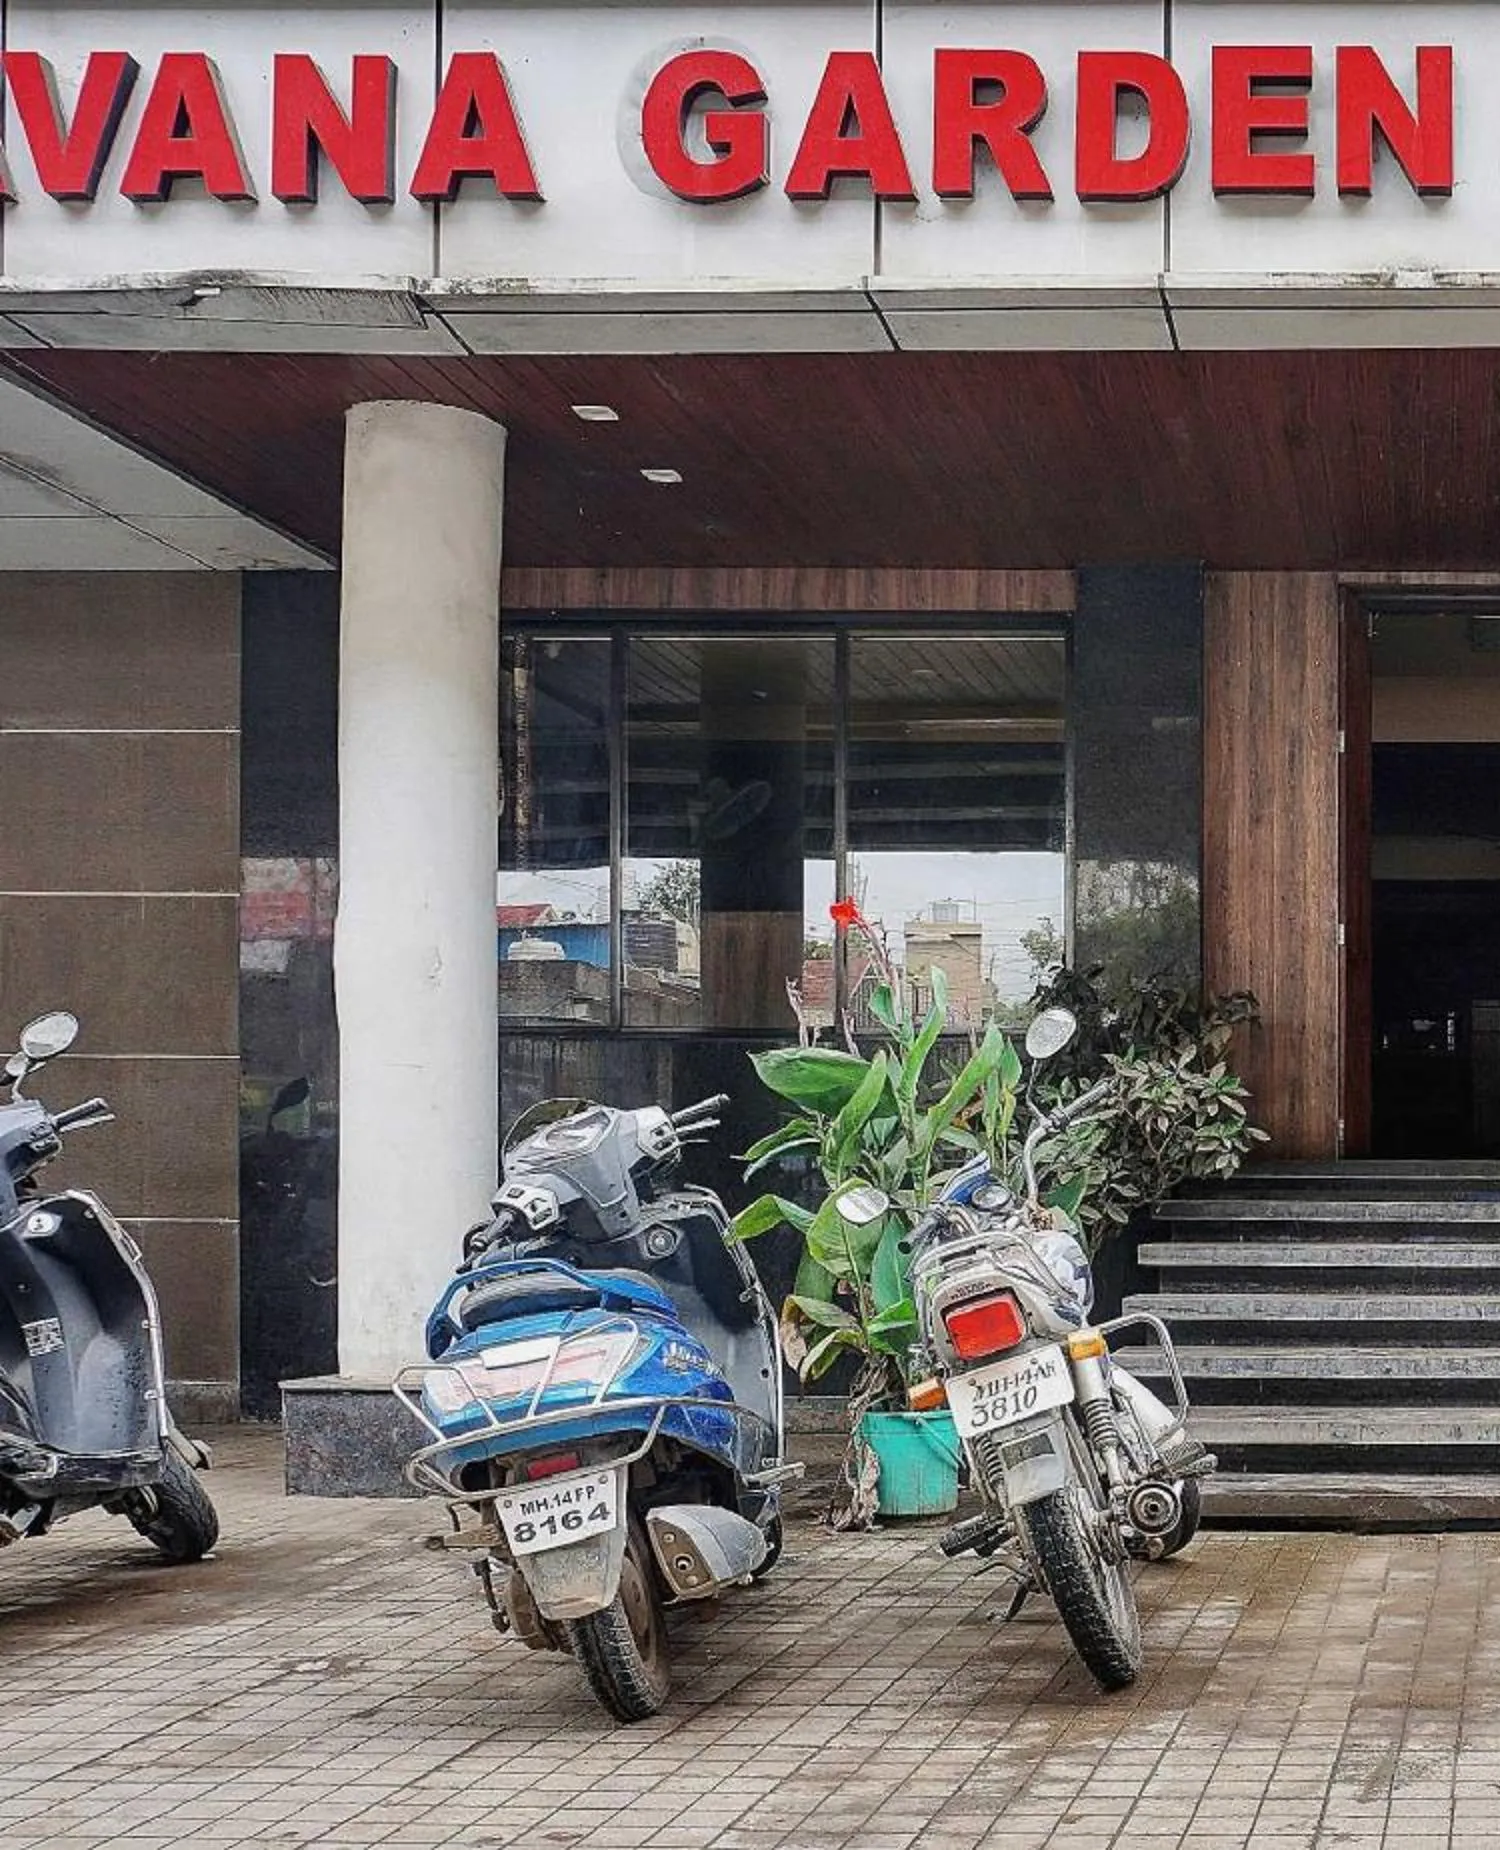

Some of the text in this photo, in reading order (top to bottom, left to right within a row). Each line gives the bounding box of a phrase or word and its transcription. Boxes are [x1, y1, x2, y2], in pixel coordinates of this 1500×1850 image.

[0, 51, 545, 203] VANA
[641, 45, 1453, 202] GARDEN
[513, 1501, 611, 1543] 8164
